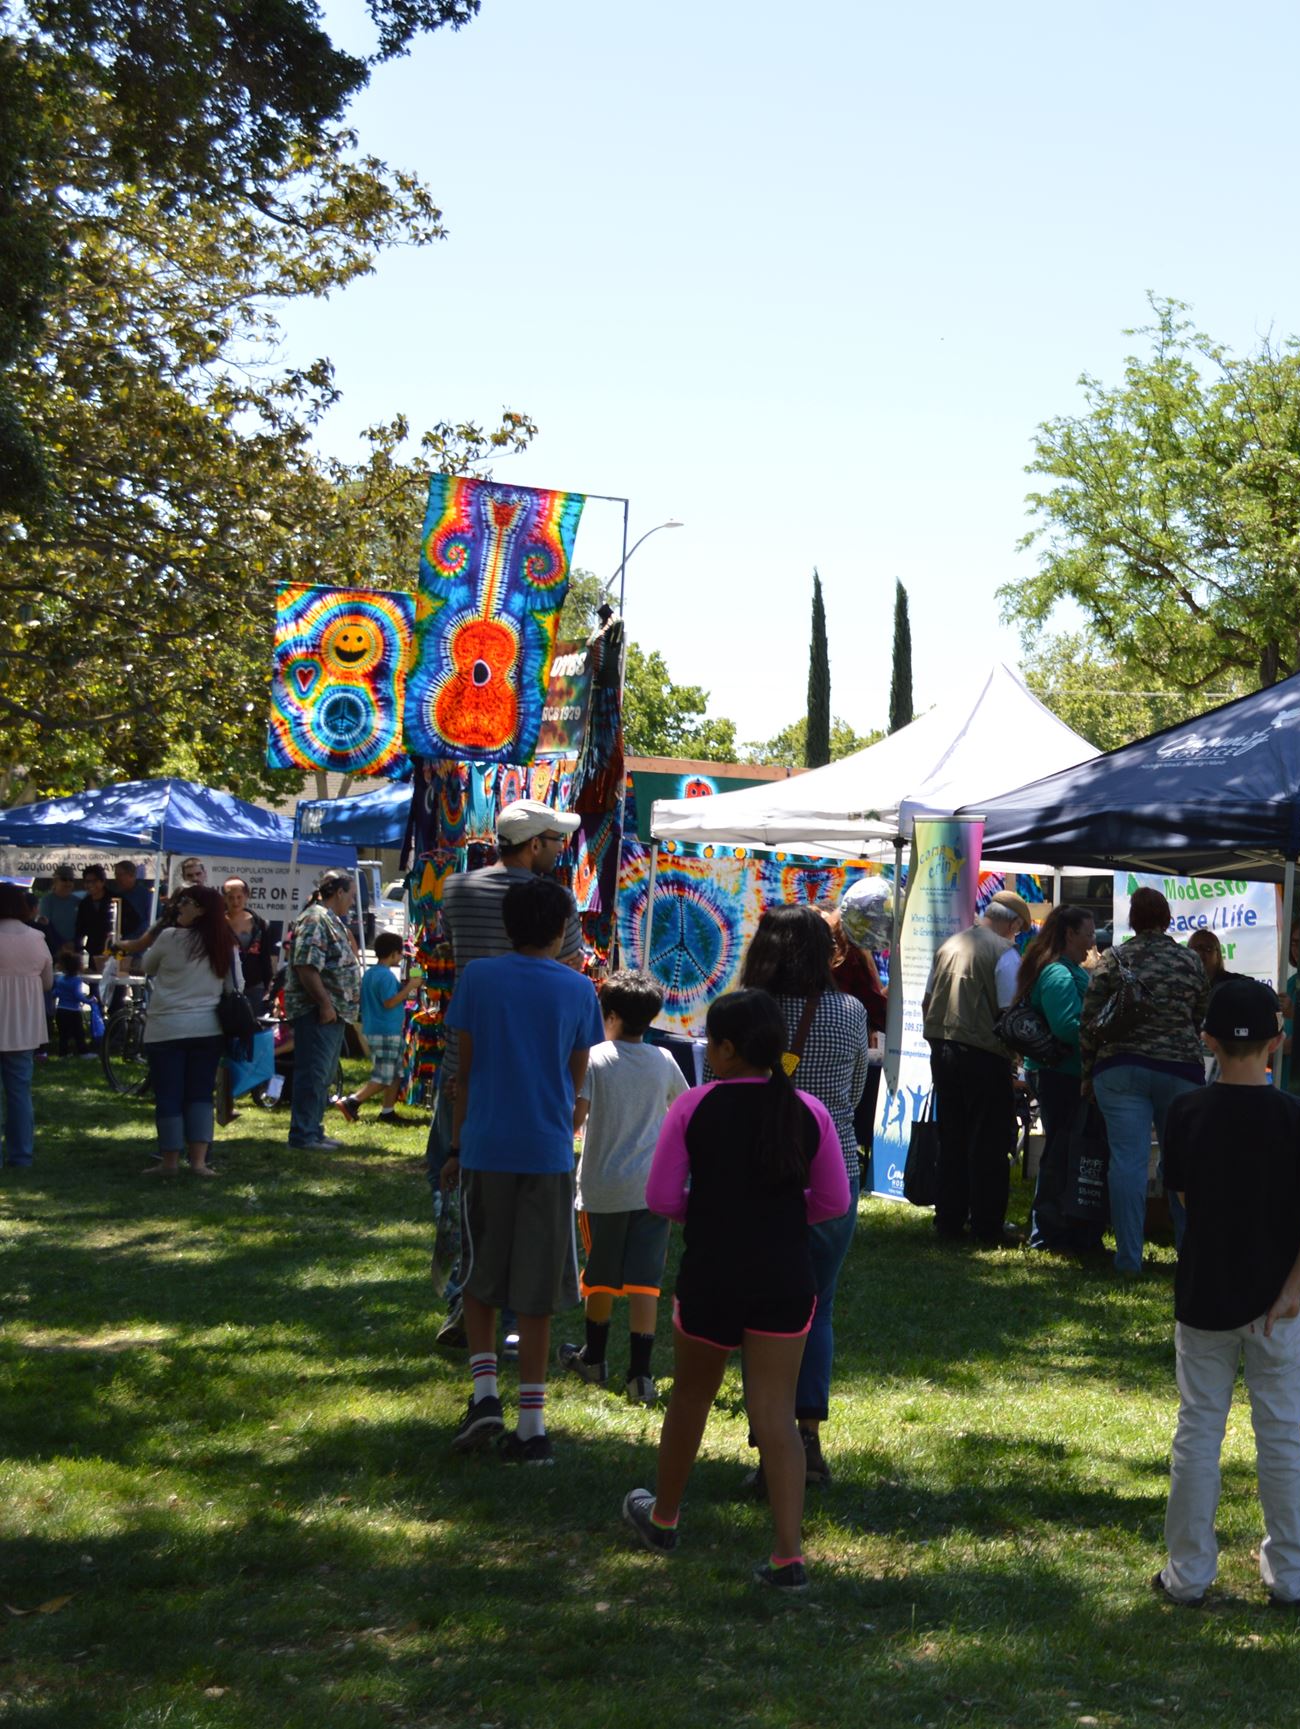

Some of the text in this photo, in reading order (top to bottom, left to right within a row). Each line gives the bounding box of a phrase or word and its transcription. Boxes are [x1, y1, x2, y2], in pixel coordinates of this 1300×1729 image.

[237, 866, 273, 874] POPULATION
[270, 888, 299, 900] ONE
[1163, 876, 1248, 901] Modesto
[1169, 913, 1208, 932] eace
[1222, 904, 1257, 928] Life
